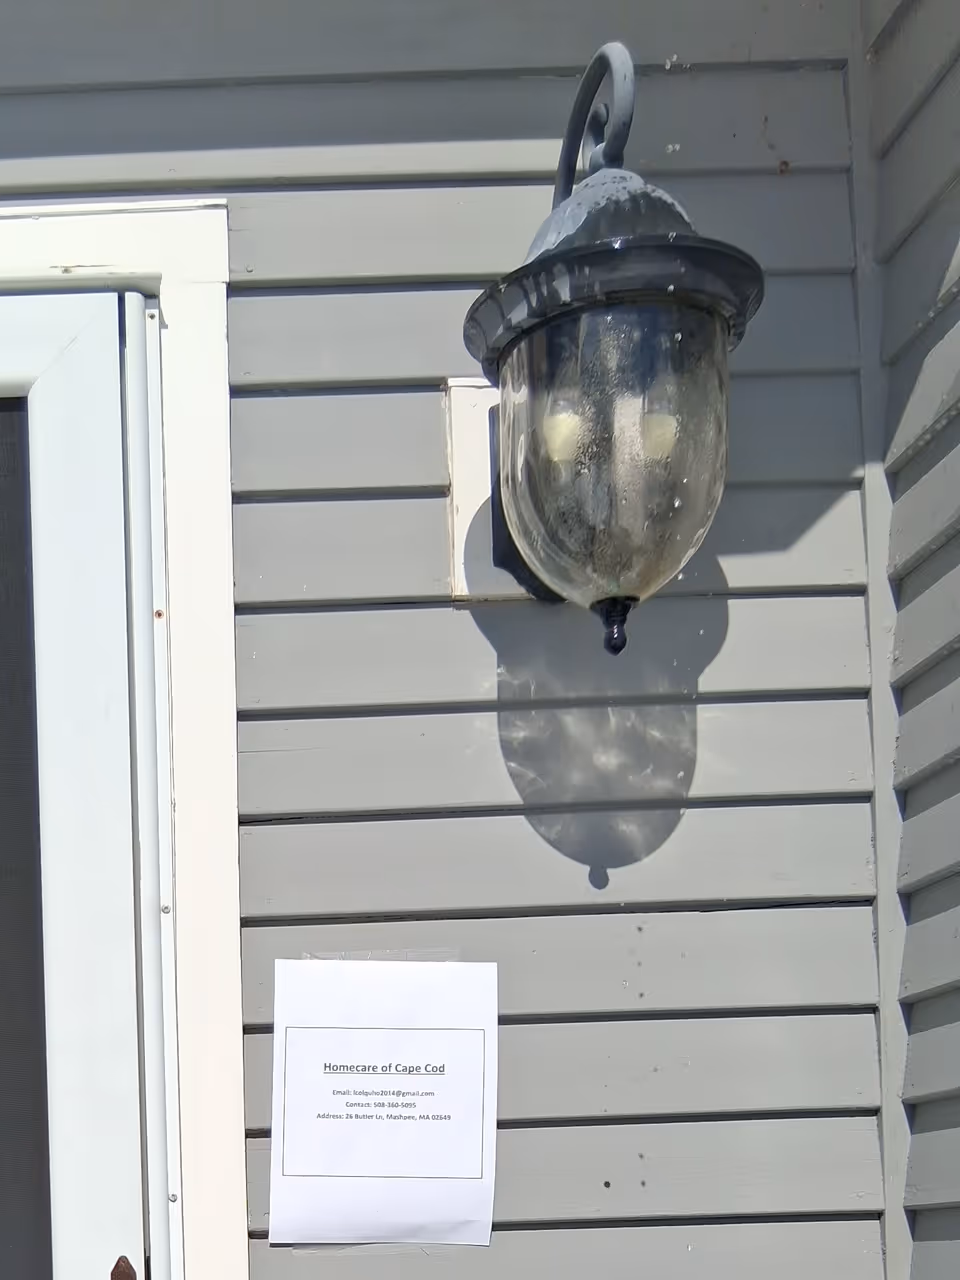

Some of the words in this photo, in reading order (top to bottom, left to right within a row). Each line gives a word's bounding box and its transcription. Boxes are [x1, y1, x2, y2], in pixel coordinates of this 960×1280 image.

[323, 1062, 378, 1073] Homecare
[381, 1062, 392, 1073] of
[394, 1063, 422, 1075] Cape
[424, 1063, 445, 1073] Cod
[316, 1112, 344, 1120] Address:
